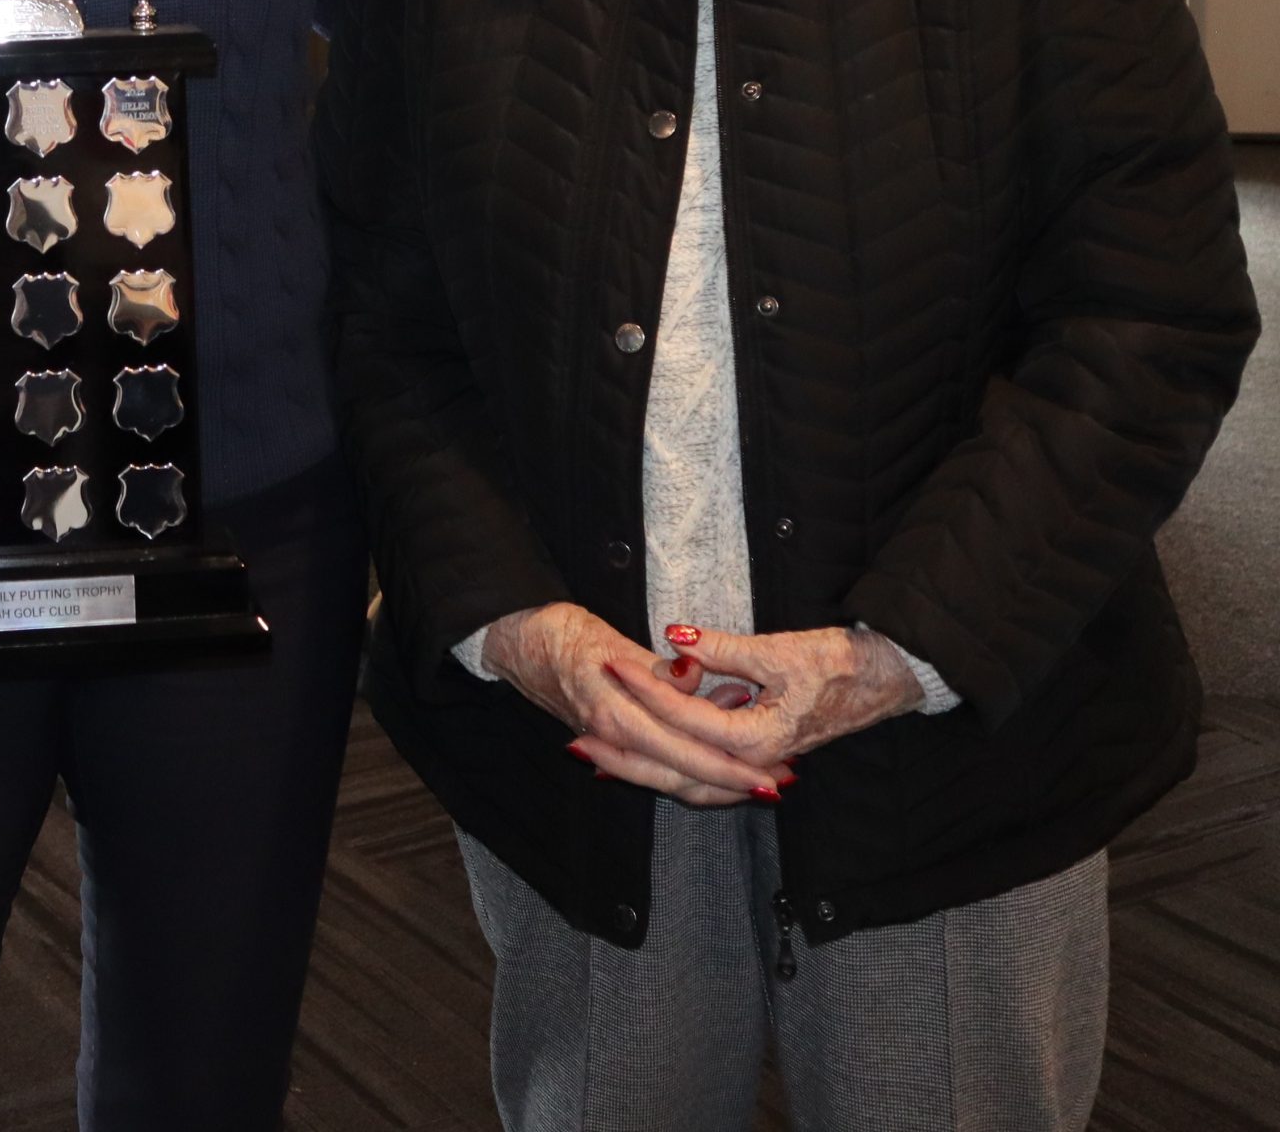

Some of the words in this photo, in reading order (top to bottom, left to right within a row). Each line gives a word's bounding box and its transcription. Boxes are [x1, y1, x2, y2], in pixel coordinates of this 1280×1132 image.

[121, 101, 150, 111] HELEN
[20, 588, 72, 601] PUTTING
[75, 584, 123, 597] TROPHY
[13, 606, 46, 618] GOLF
[49, 604, 81, 617] CLUB
